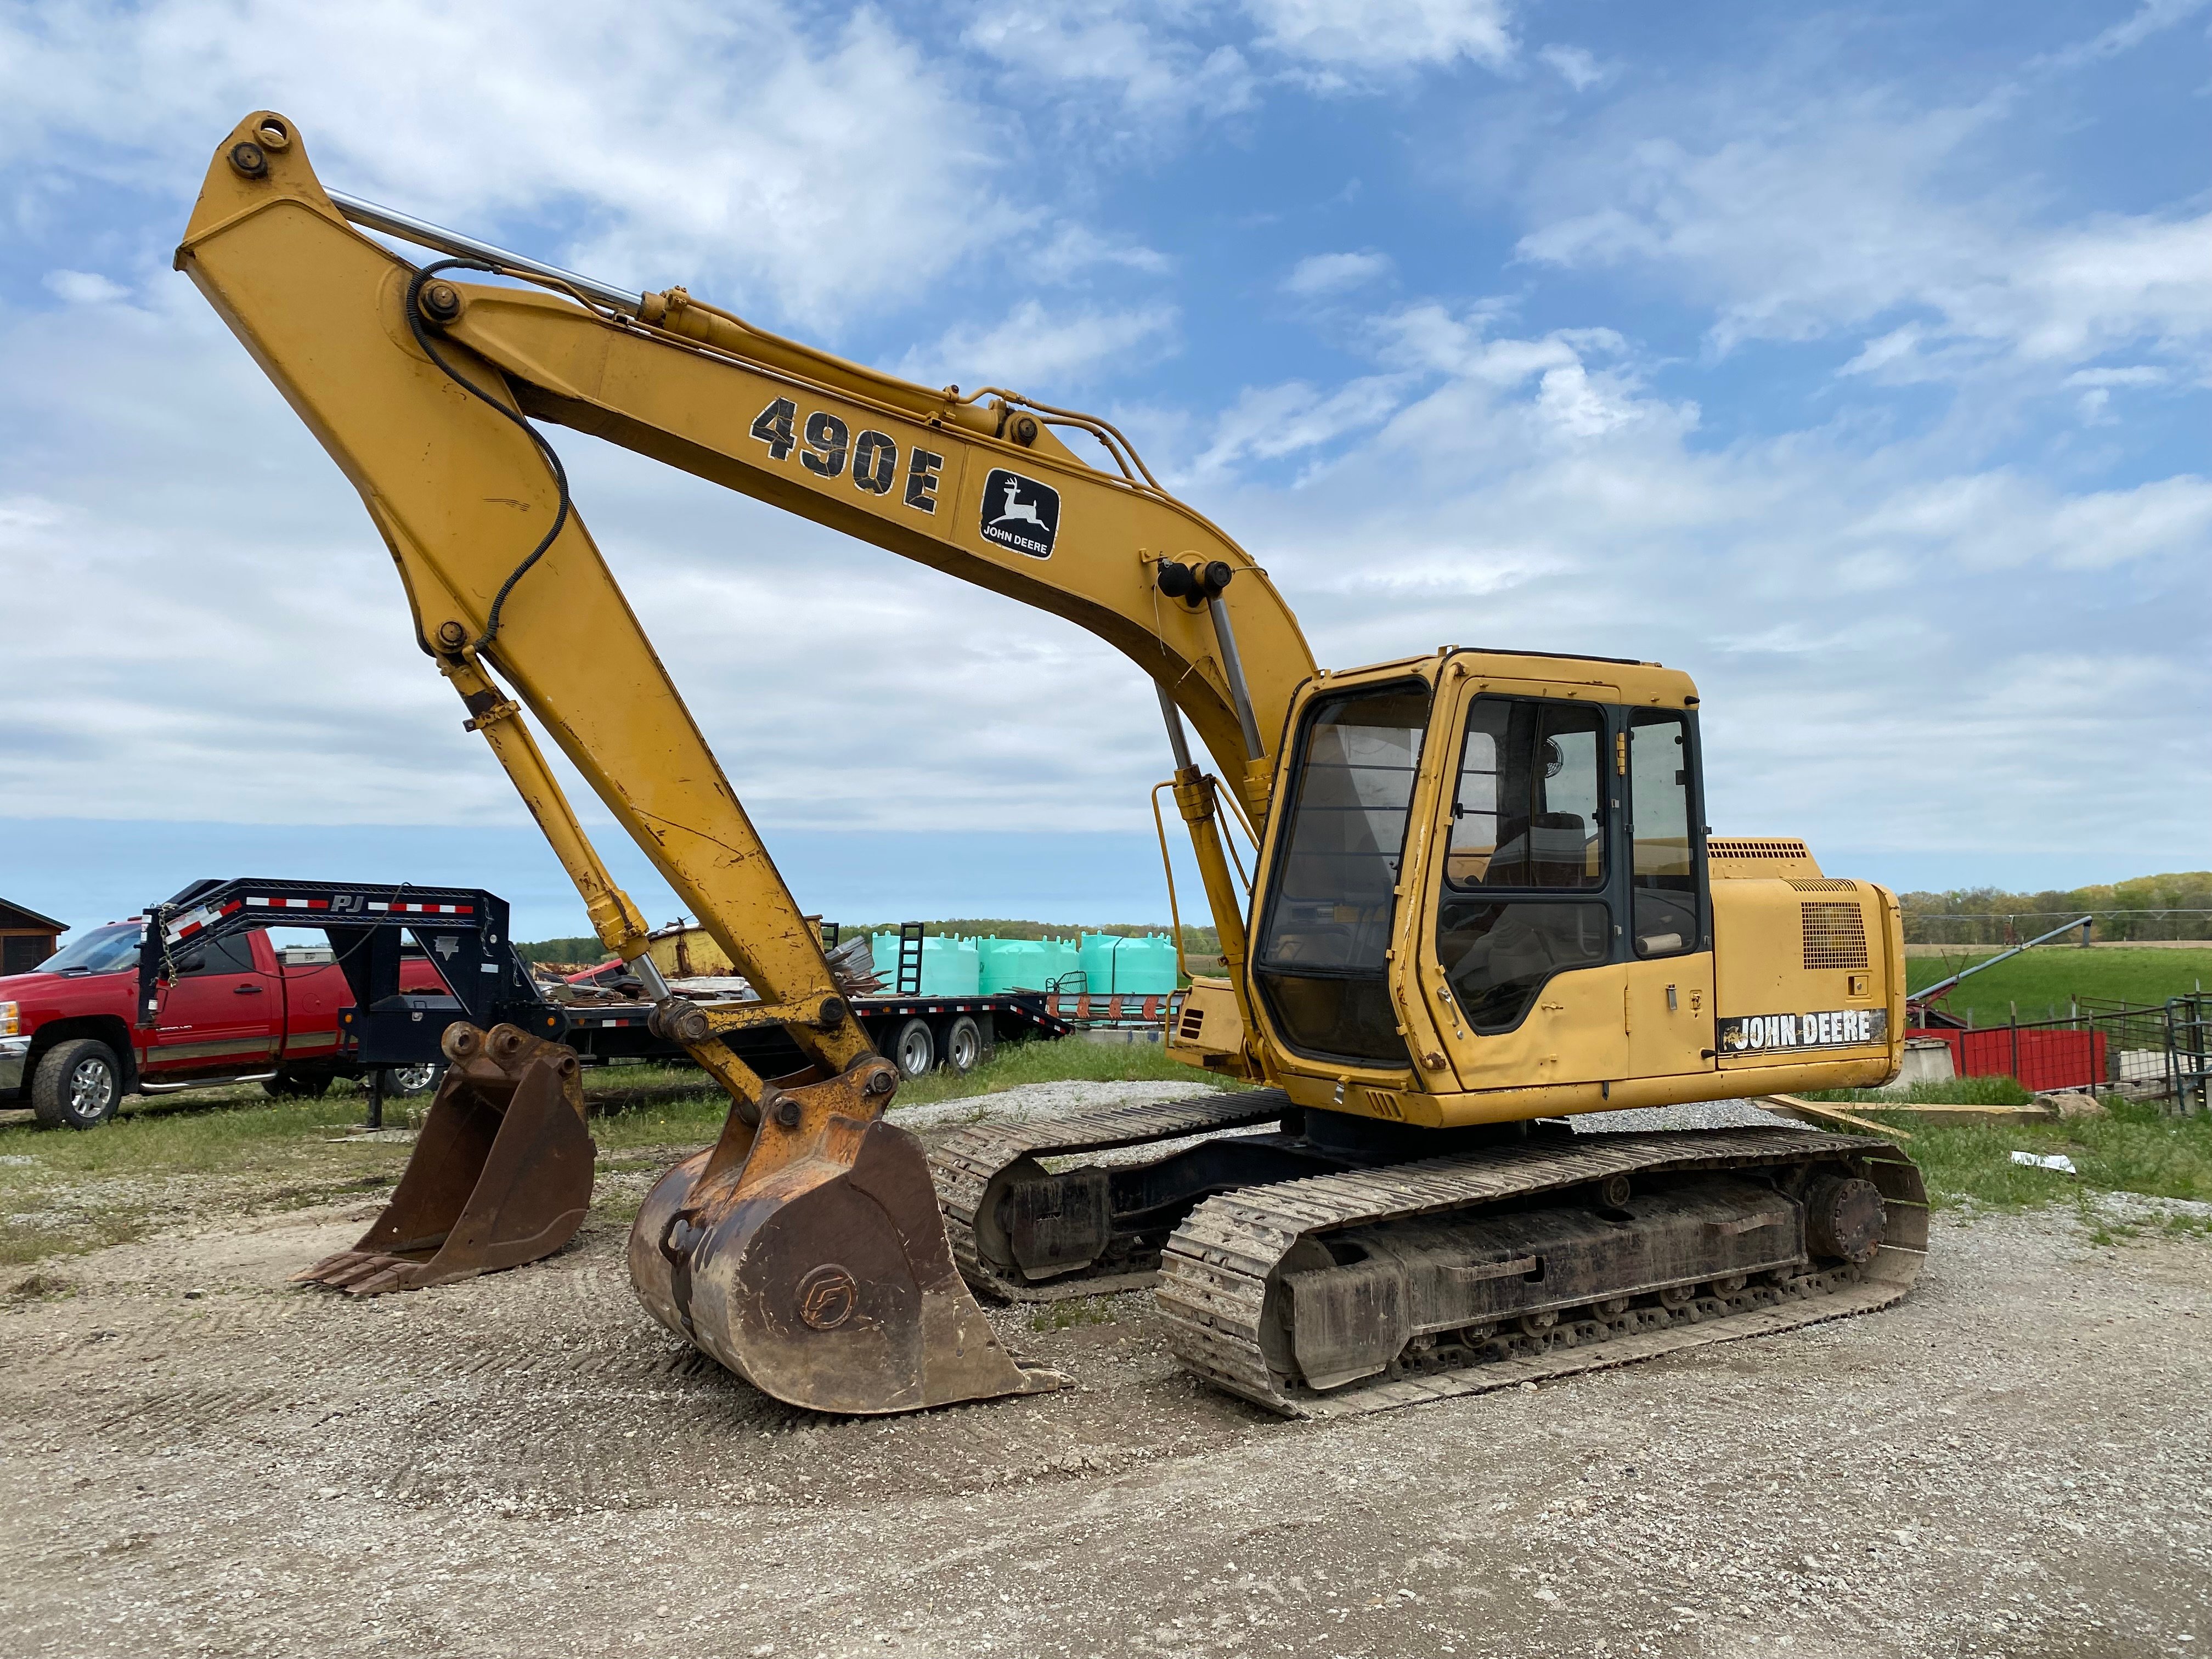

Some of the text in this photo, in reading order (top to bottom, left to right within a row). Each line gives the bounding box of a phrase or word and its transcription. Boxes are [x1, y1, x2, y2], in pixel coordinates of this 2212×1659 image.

[749, 395, 945, 515] 490E
[983, 525, 1048, 554] JOHN DEERE
[330, 895, 364, 912] PJ
[1734, 1010, 1870, 1050] JOHN DEERE
